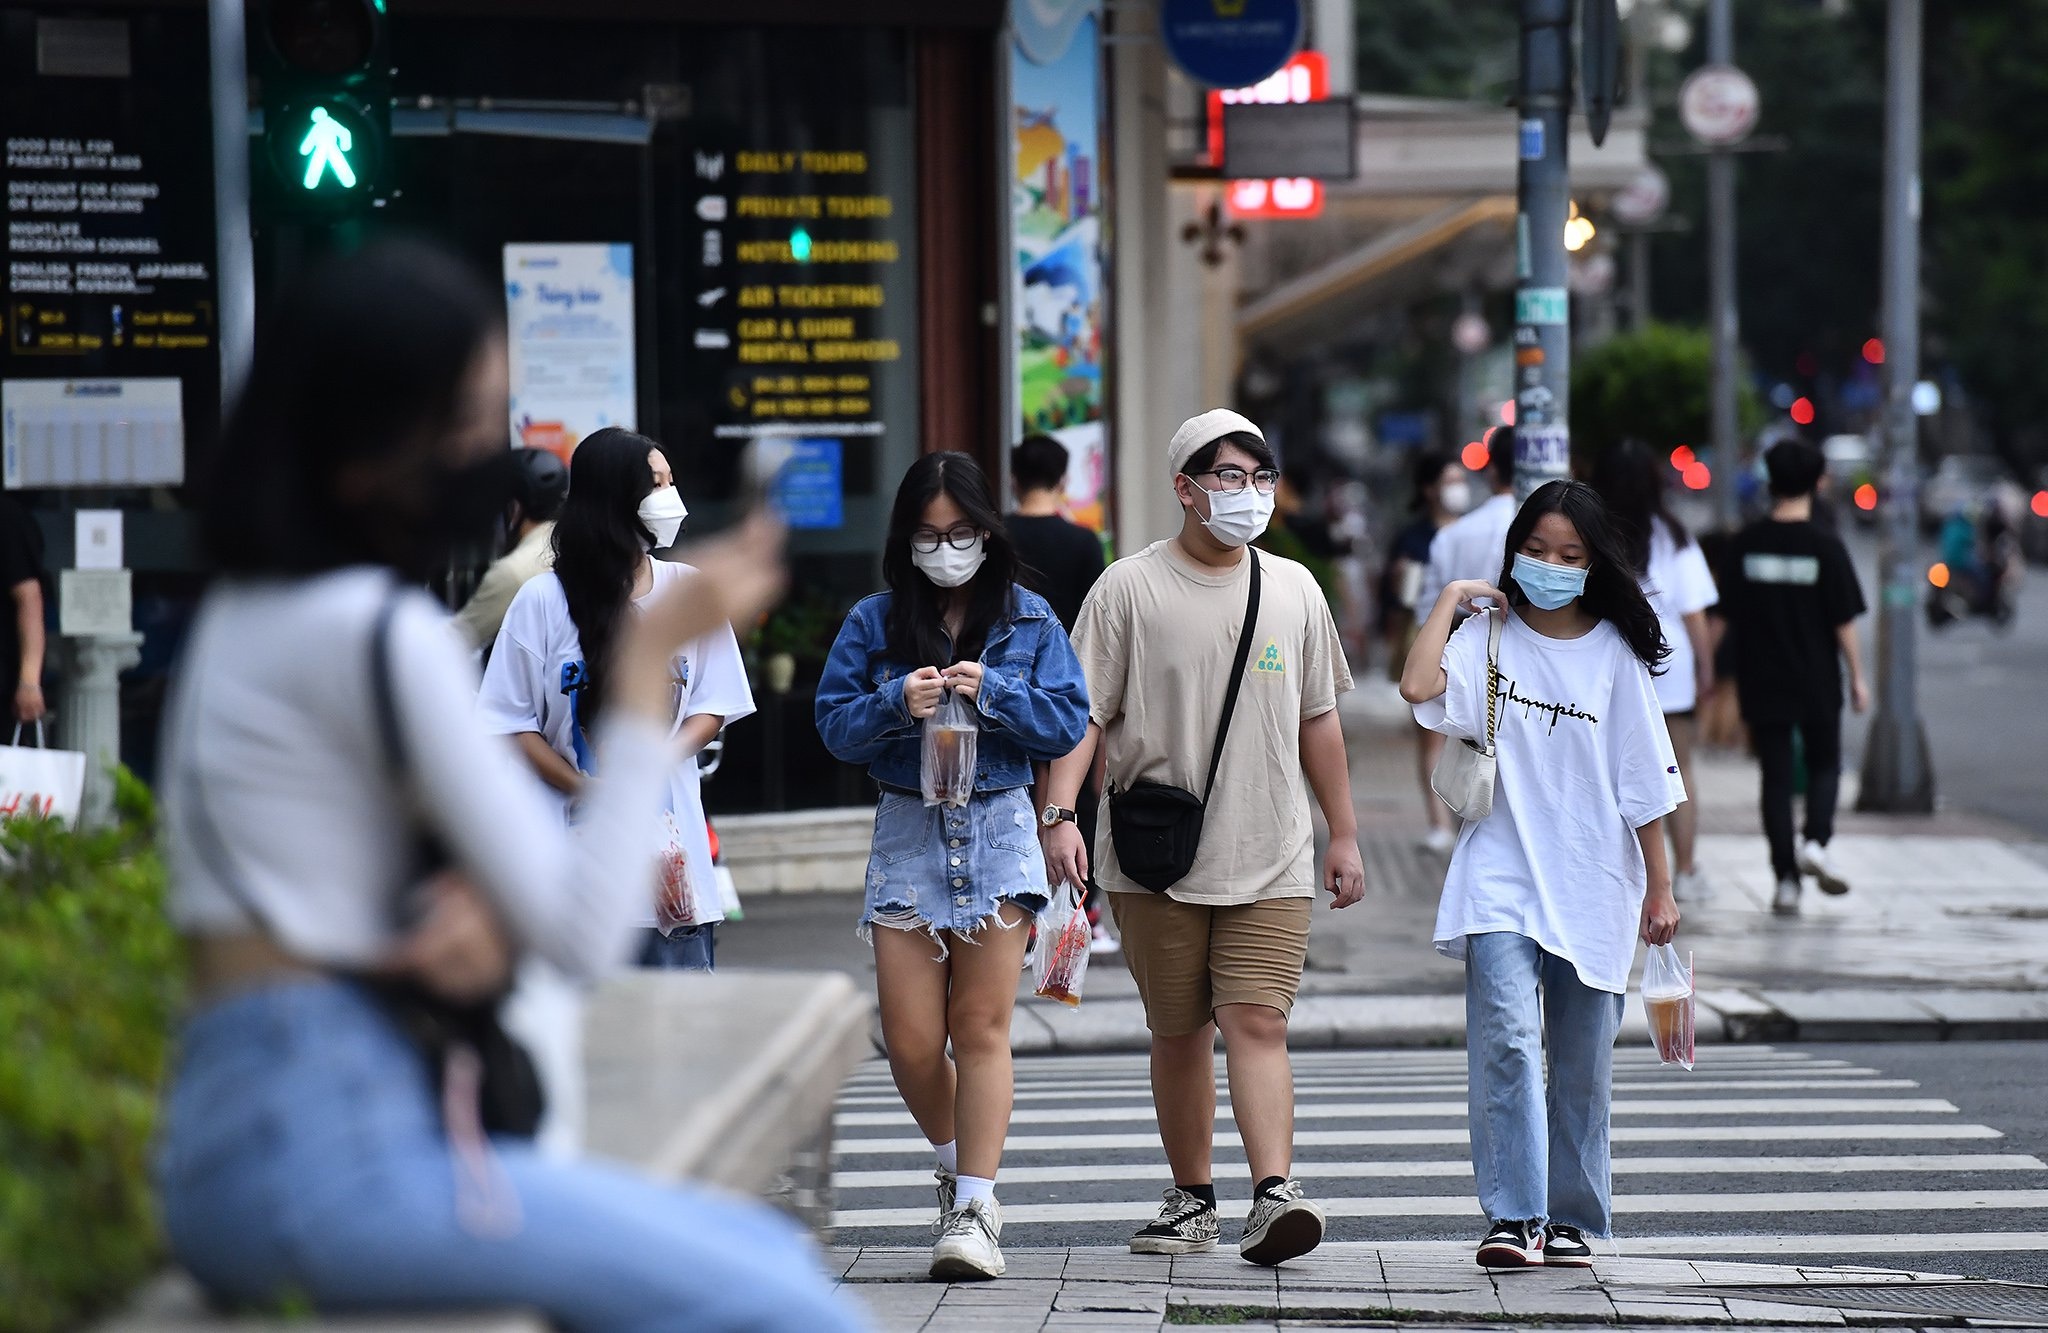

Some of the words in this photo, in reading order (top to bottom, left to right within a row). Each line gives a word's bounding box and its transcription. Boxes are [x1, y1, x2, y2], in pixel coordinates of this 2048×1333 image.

[736, 151, 795, 173] DAILY
[802, 151, 867, 173] TOURS
[736, 196, 821, 218] PRIVATE
[827, 196, 893, 218] TOURS
[736, 241, 798, 263] HOTE
[738, 284, 775, 308] AIR
[778, 284, 884, 308] TICKETING
[737, 318, 778, 340] CAR
[798, 317, 855, 339] GUIDE
[738, 341, 808, 363] RENTAL
[813, 339, 900, 361] SERVICES
